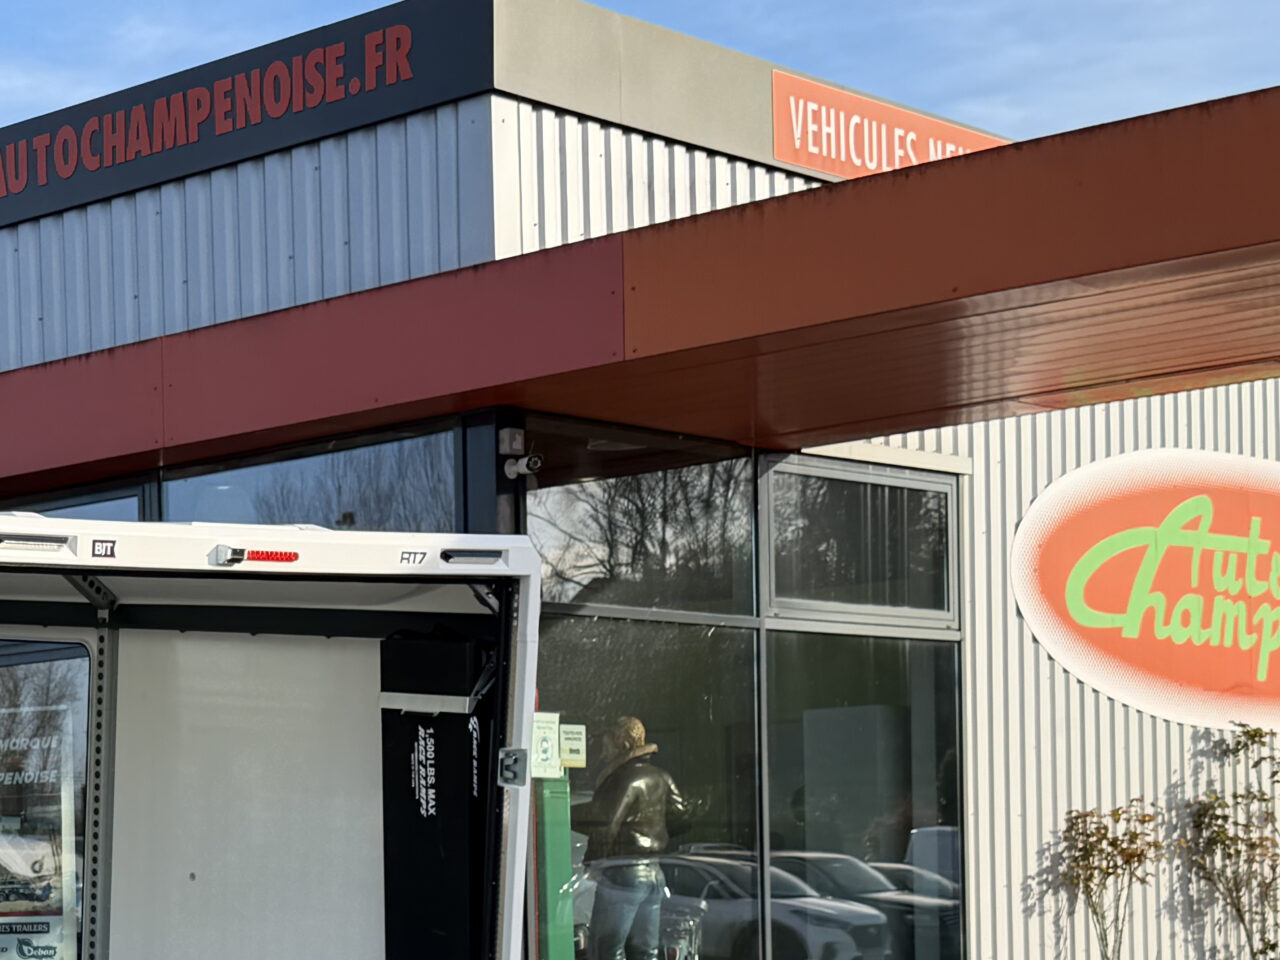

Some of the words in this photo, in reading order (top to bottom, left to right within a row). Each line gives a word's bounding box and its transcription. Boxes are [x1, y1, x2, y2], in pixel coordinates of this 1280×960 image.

[789, 95, 918, 172] VEHICULES
[94, 541, 114, 556] BJT
[400, 551, 427, 565] RT7
[426, 759, 436, 787] LBS.
[427, 788, 437, 816] MAX
[12, 923, 48, 932] TRAILERS
